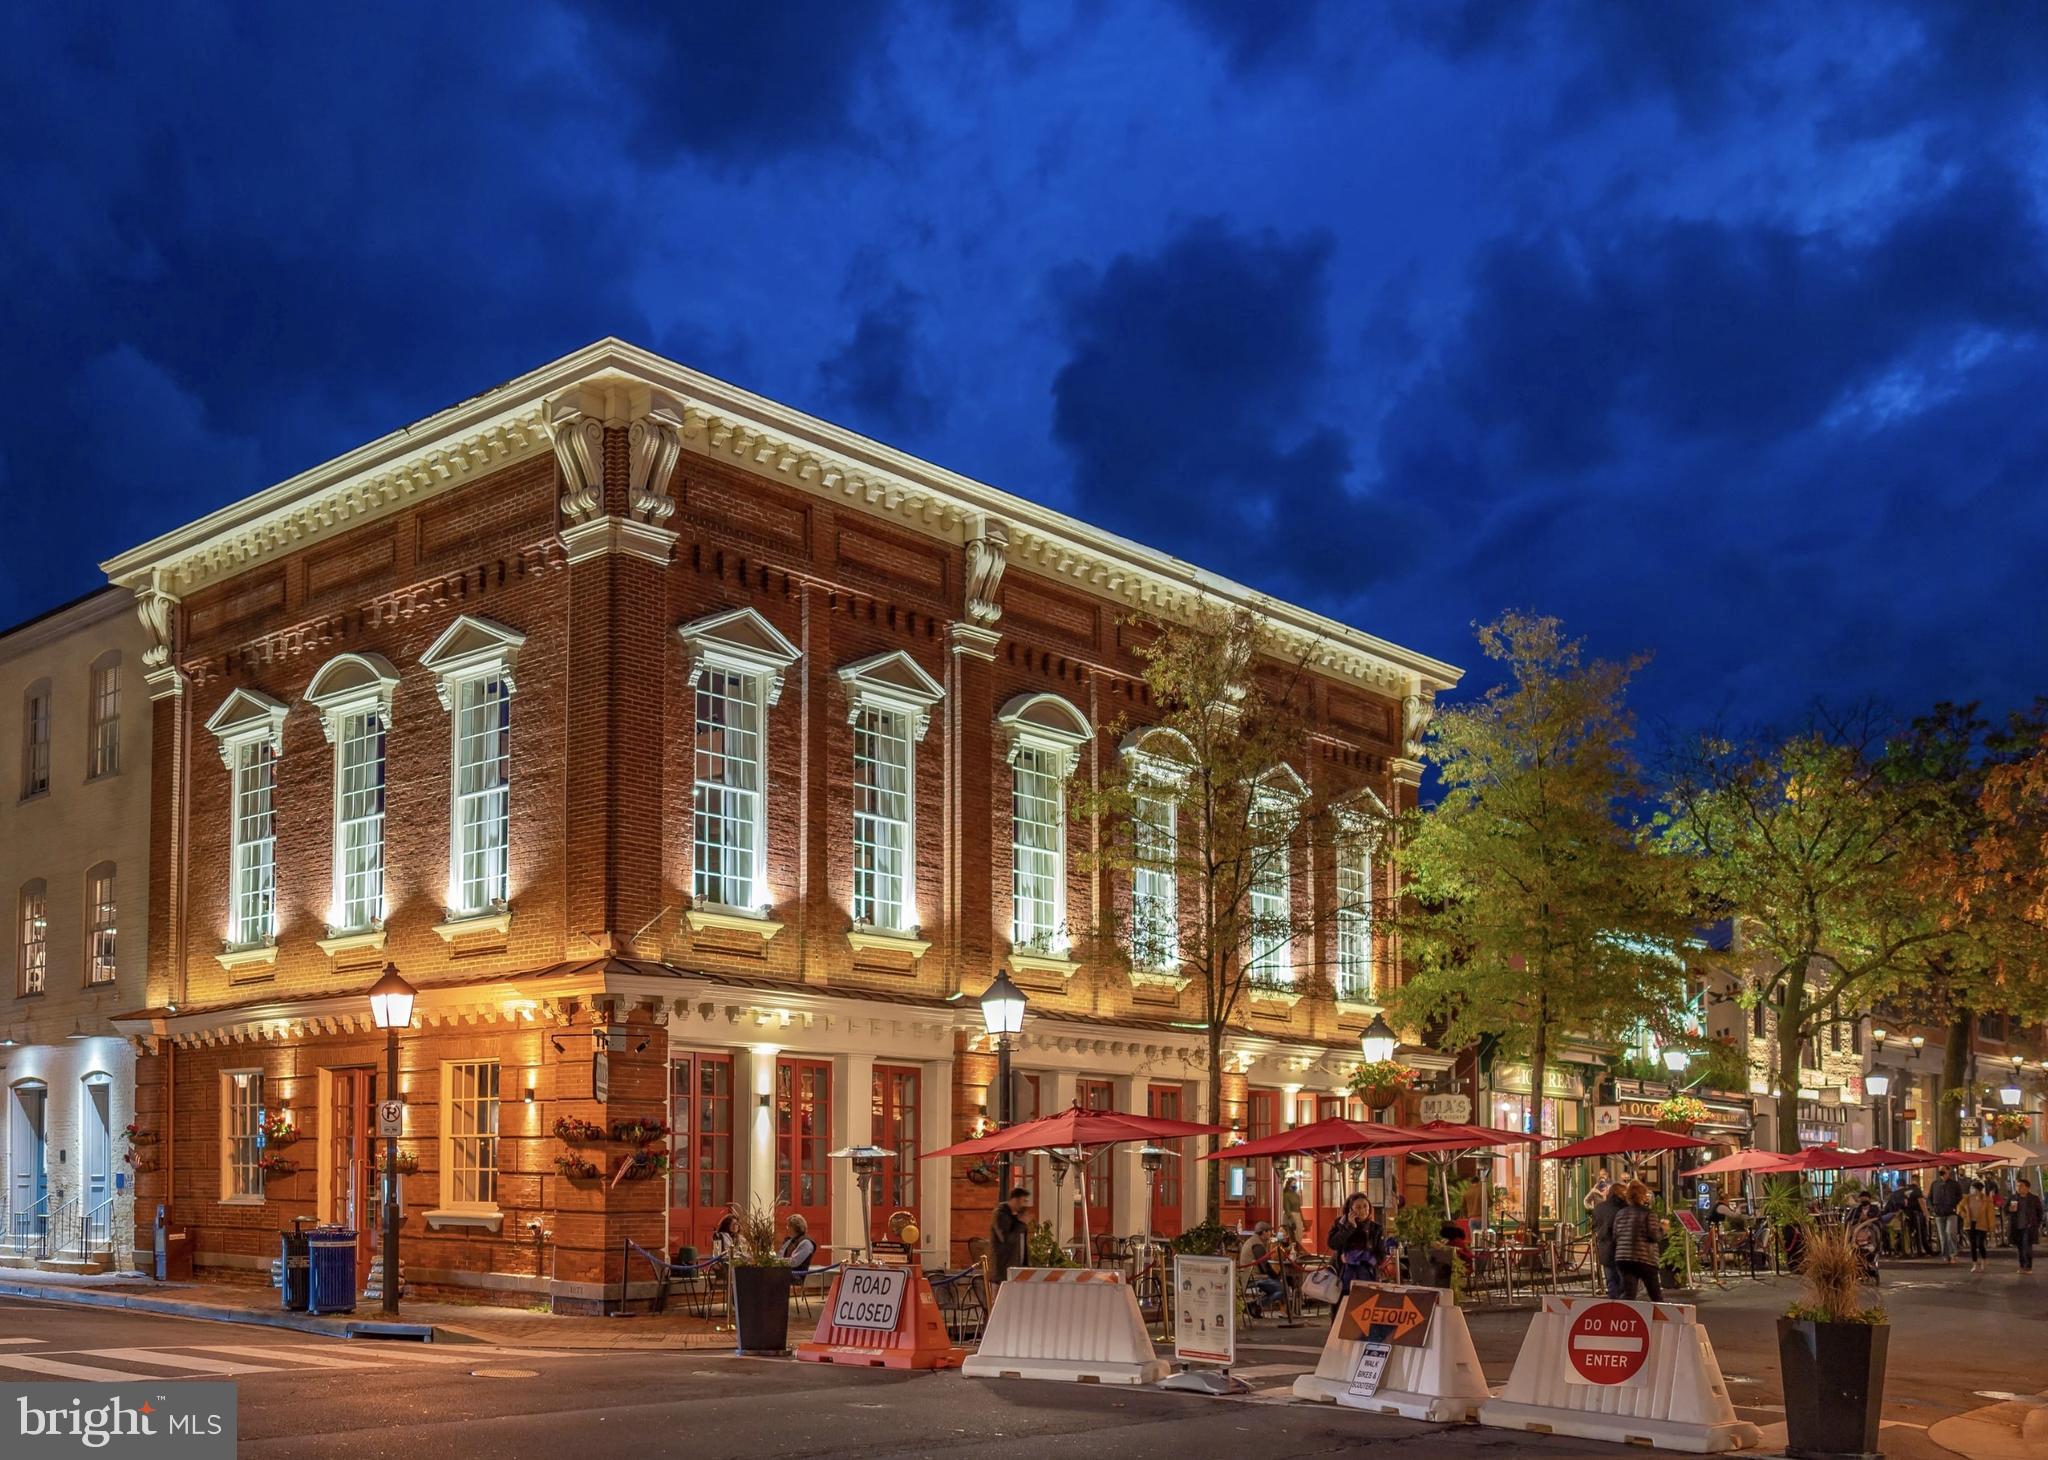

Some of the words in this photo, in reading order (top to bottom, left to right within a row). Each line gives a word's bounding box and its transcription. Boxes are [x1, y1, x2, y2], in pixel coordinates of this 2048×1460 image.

[1423, 1100, 1466, 1114] MIA'S
[852, 1275, 892, 1295] ROAD
[839, 1301, 893, 1323] CLOSED
[1361, 1307, 1417, 1326] DETOUR
[1584, 1318, 1601, 1331] DO
[1610, 1319, 1637, 1333] NOT
[1364, 1360, 1380, 1368] WALK
[1585, 1354, 1628, 1368] ENTER
[1357, 1370, 1372, 1379] BIKES
[1351, 1381, 1375, 1391] SCOOTERS
